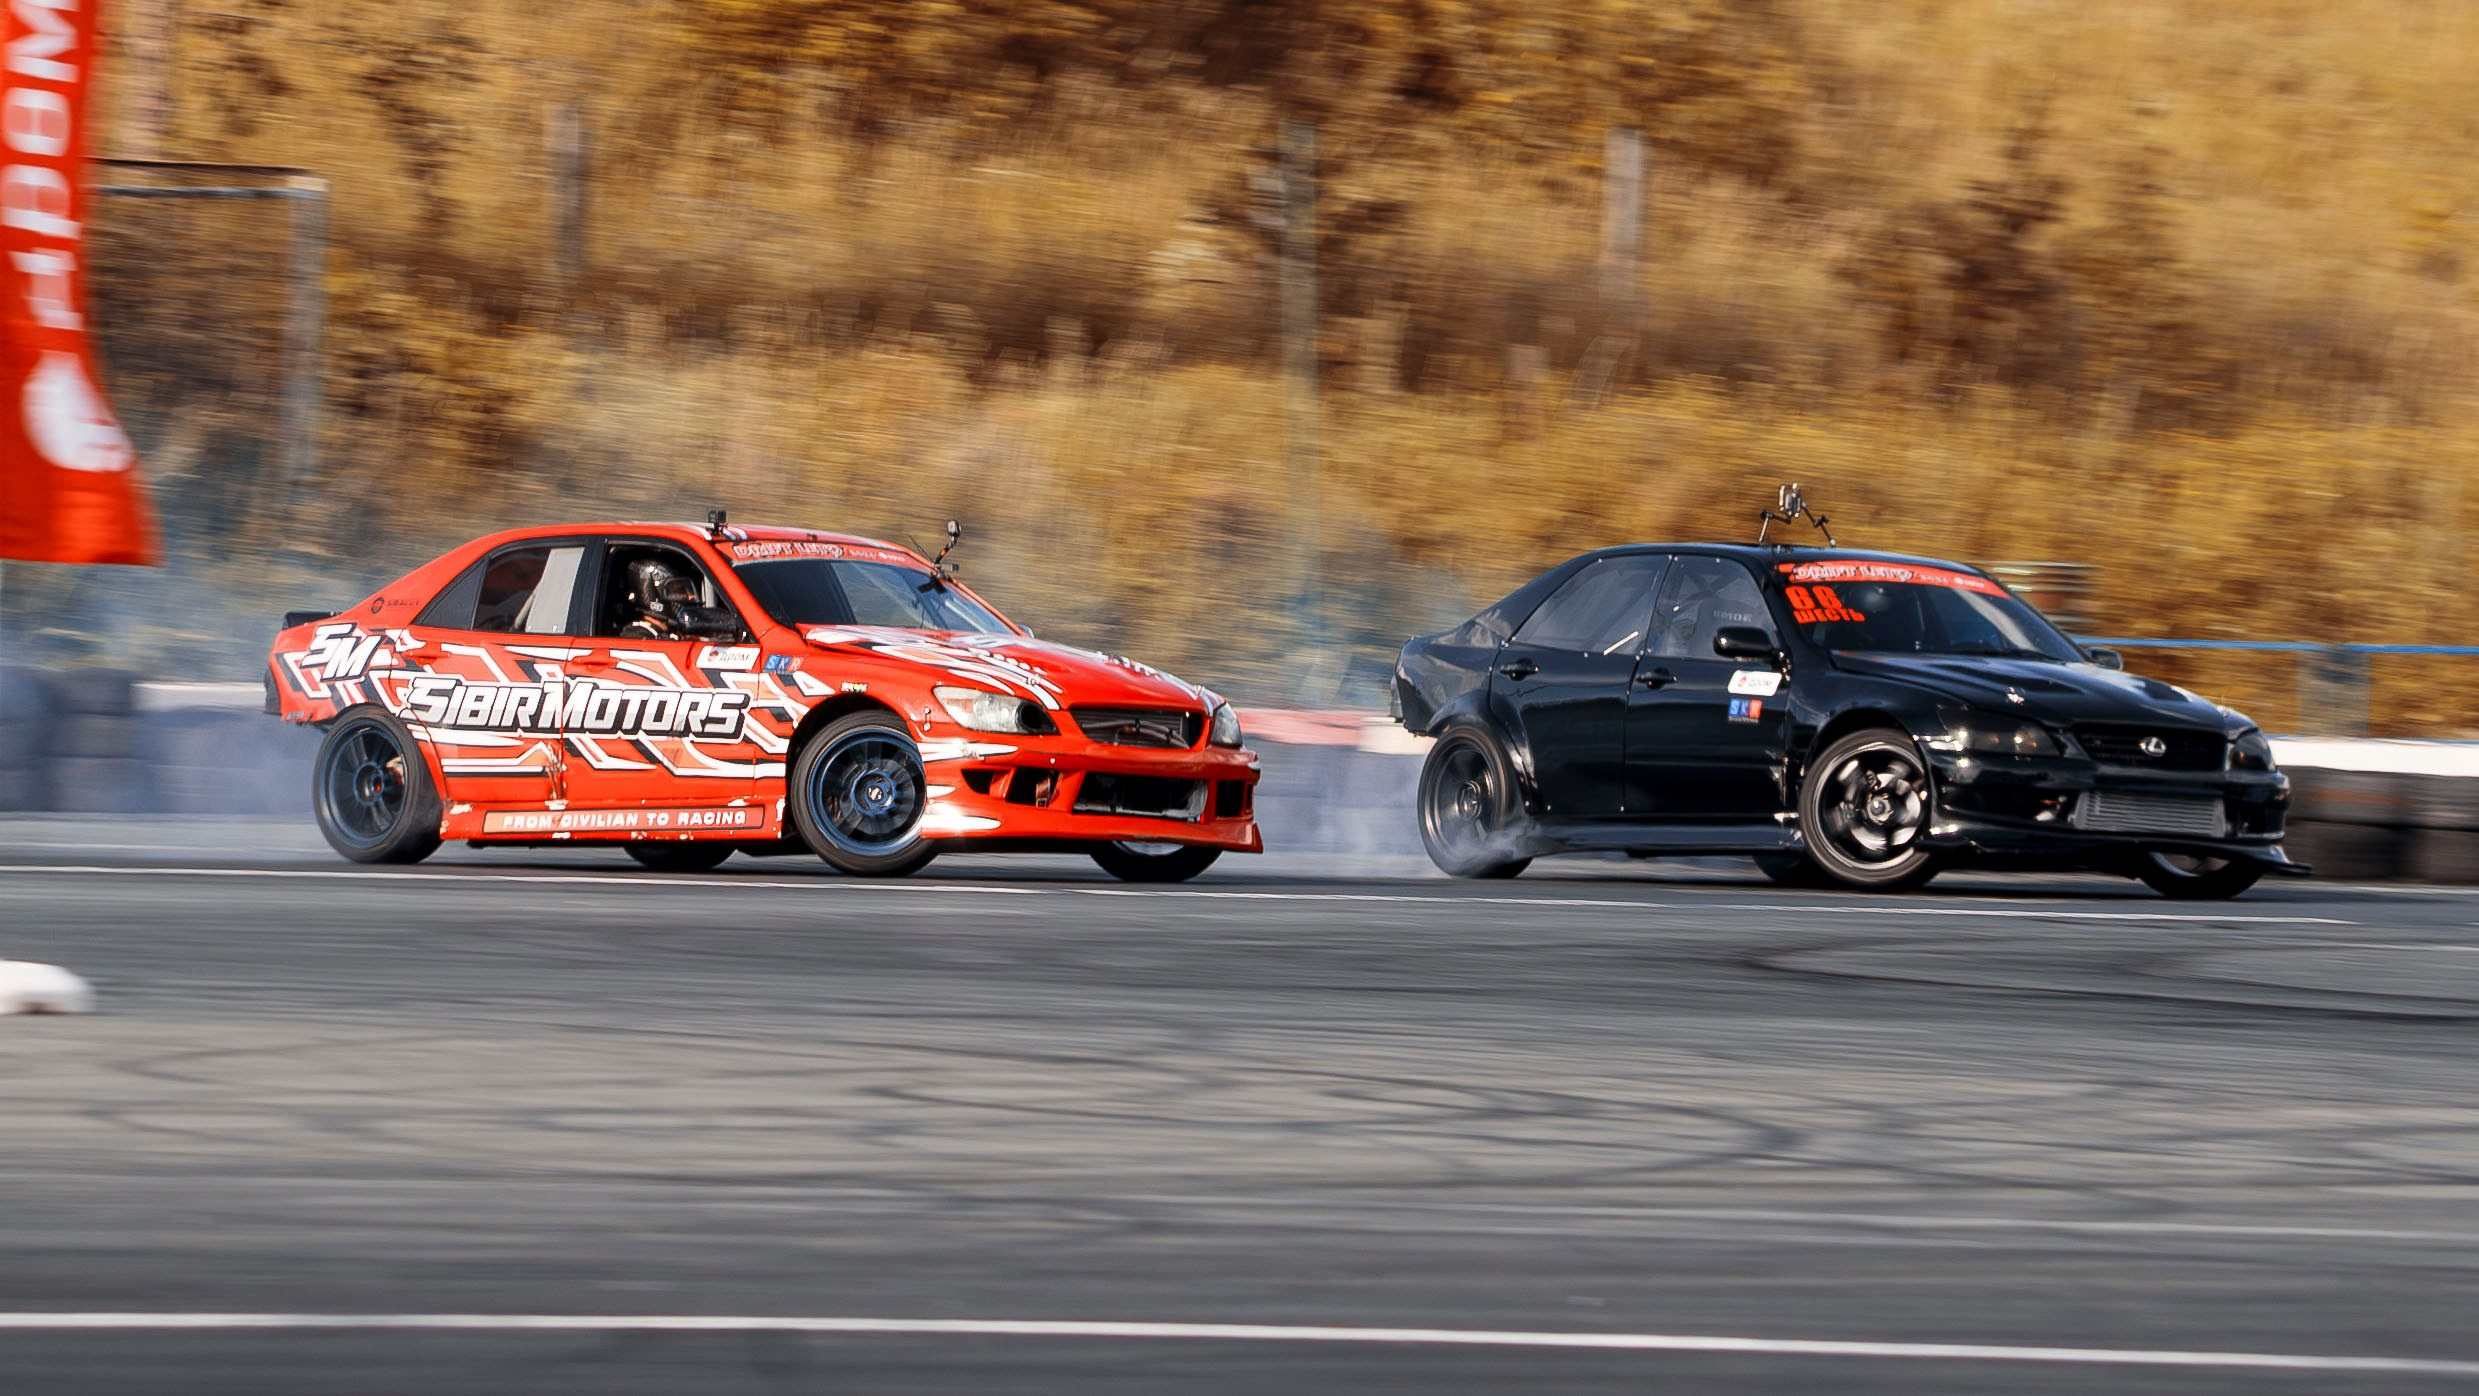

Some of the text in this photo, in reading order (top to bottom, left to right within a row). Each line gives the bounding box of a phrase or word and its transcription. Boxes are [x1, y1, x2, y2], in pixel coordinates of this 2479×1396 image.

[301, 623, 383, 680] SM
[766, 655, 803, 671] SKR
[503, 810, 746, 829] FROM CIVILIAN TO RACING
